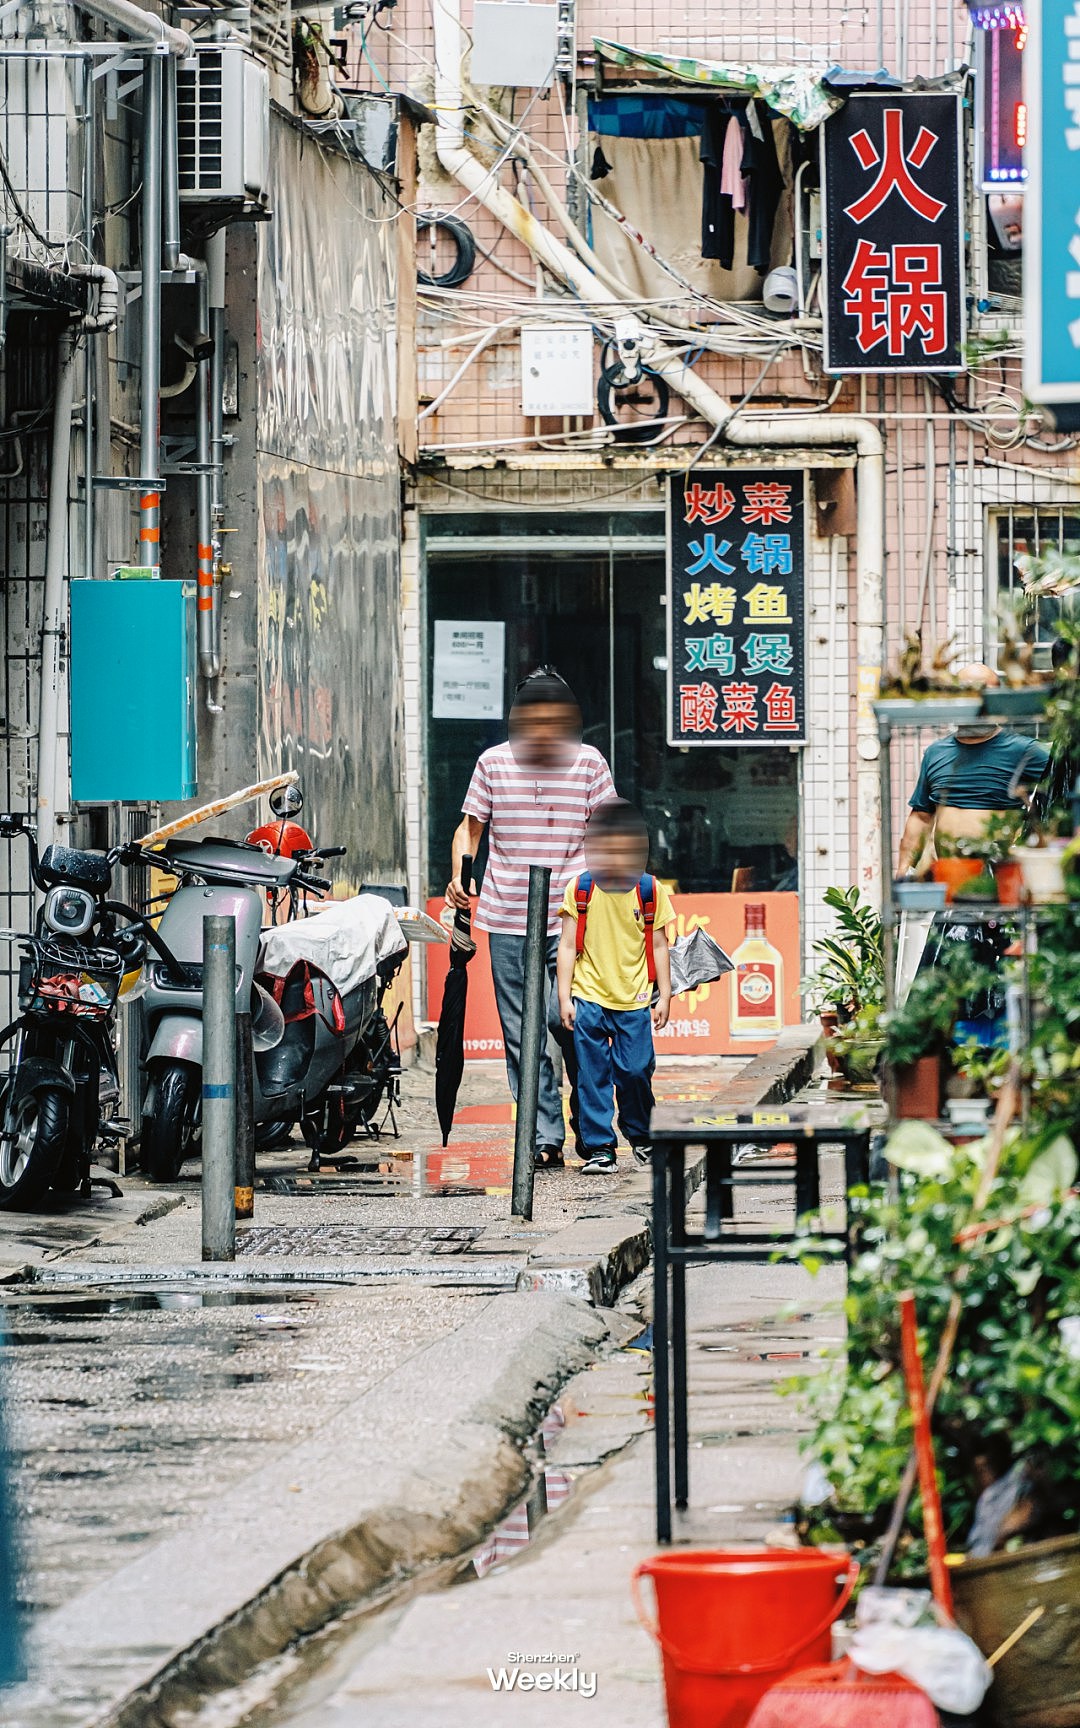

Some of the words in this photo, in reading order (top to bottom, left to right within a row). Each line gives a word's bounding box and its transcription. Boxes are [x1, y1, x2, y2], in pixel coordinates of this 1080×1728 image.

[842, 108, 947, 355] 火锅
[684, 482, 793, 526] 炒菜
[684, 532, 793, 576] 火锅
[683, 582, 793, 626] 烤鱼
[684, 632, 794, 676] 鸡煲
[679, 681, 799, 733] 酸菜鱼
[463, 1039, 505, 1051] 19070
